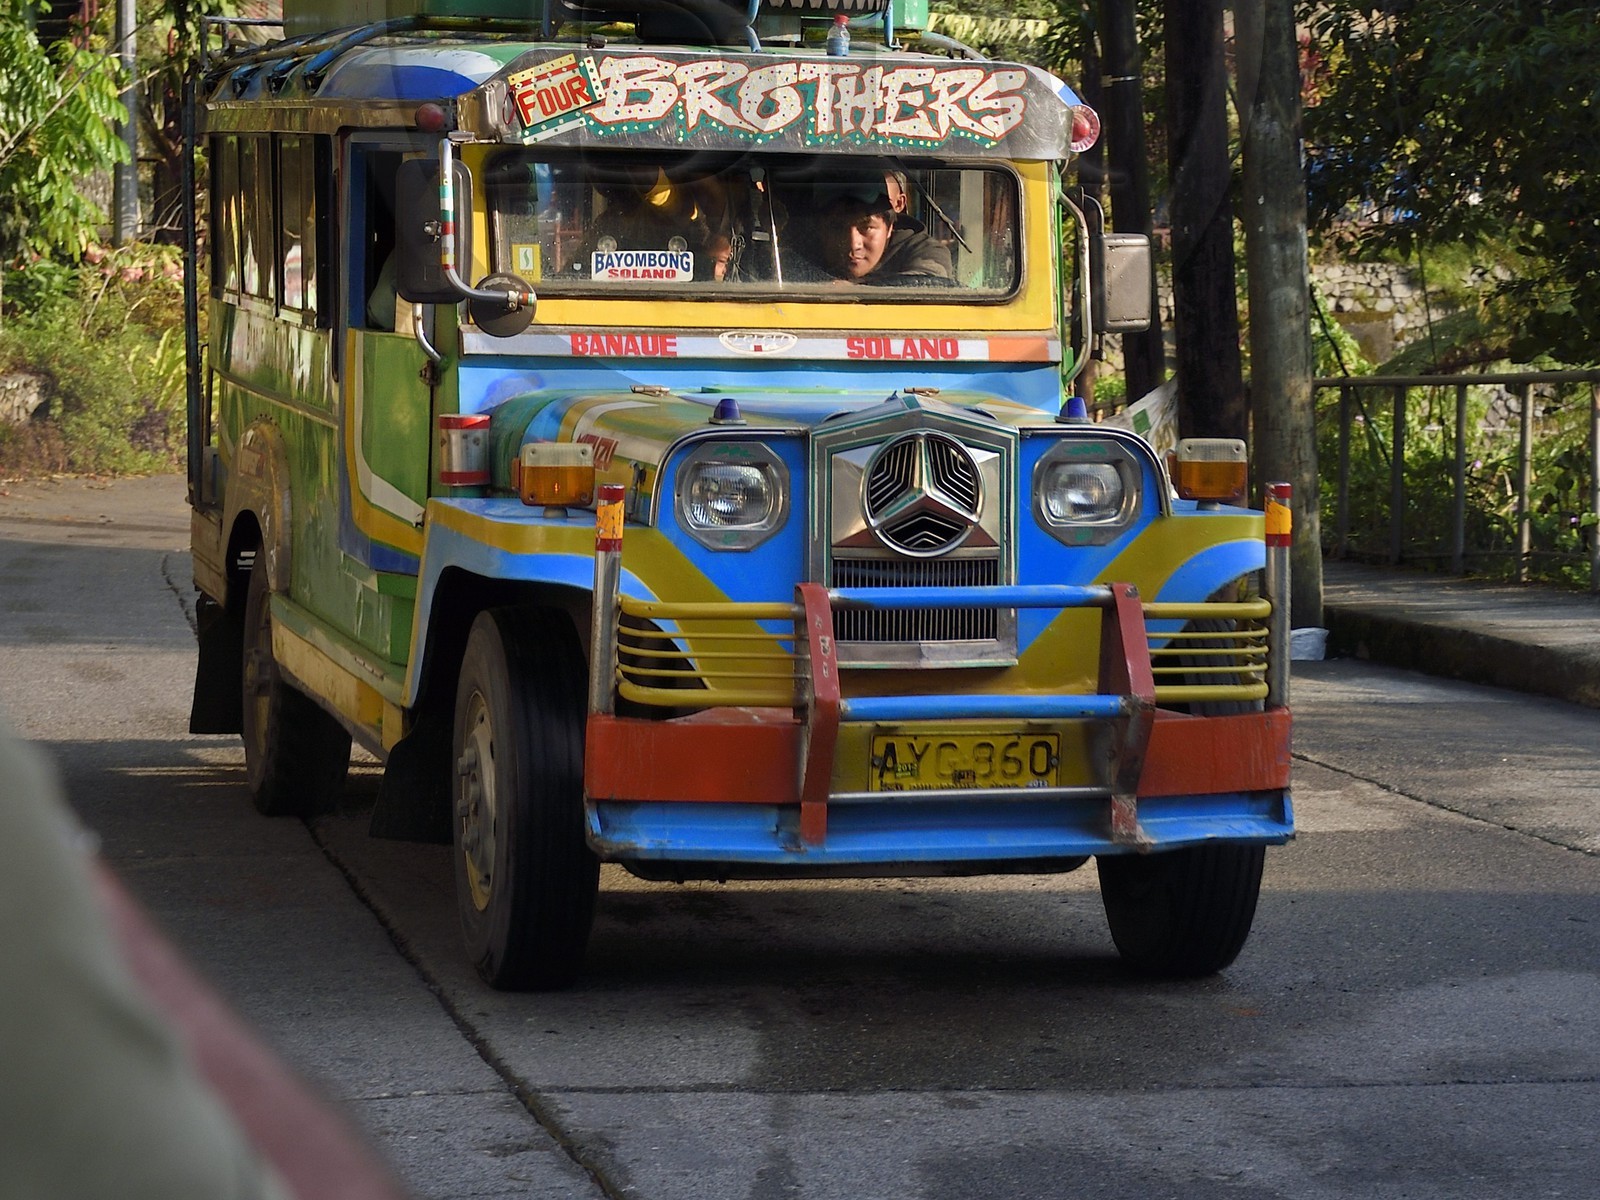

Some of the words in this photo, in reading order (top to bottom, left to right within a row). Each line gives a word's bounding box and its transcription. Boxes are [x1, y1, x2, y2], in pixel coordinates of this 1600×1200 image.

[517, 76, 592, 124] FOUR
[583, 54, 1028, 140] BROTHERS
[595, 252, 691, 274] BAYOMBONG
[608, 268, 677, 279] SOLANO
[570, 333, 677, 356] BANAUE
[846, 337, 959, 359] SOLANO
